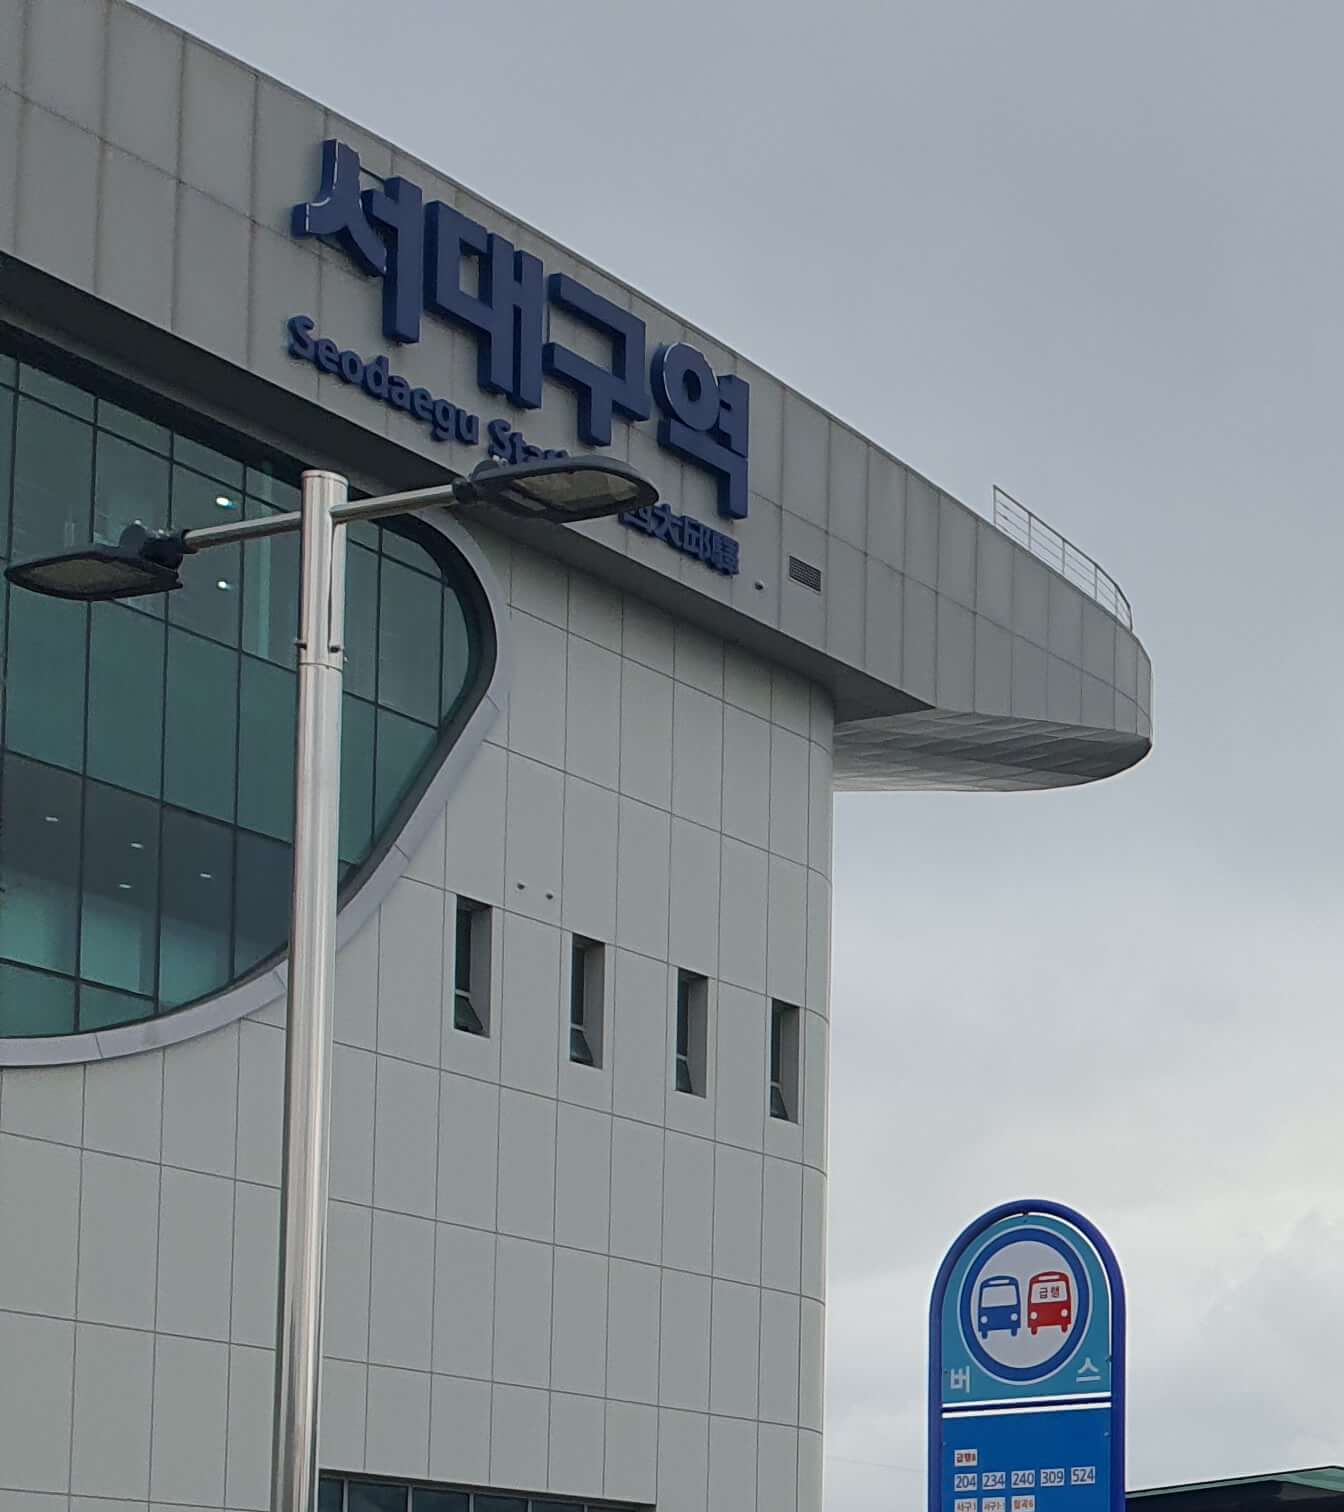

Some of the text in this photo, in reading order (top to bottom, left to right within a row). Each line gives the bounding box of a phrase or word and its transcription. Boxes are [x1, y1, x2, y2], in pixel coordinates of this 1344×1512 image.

[287, 314, 480, 446] Seodaegu
[292, 138, 750, 519] 서대구역
[956, 1468, 1094, 1489] 204 234 240 309 524
